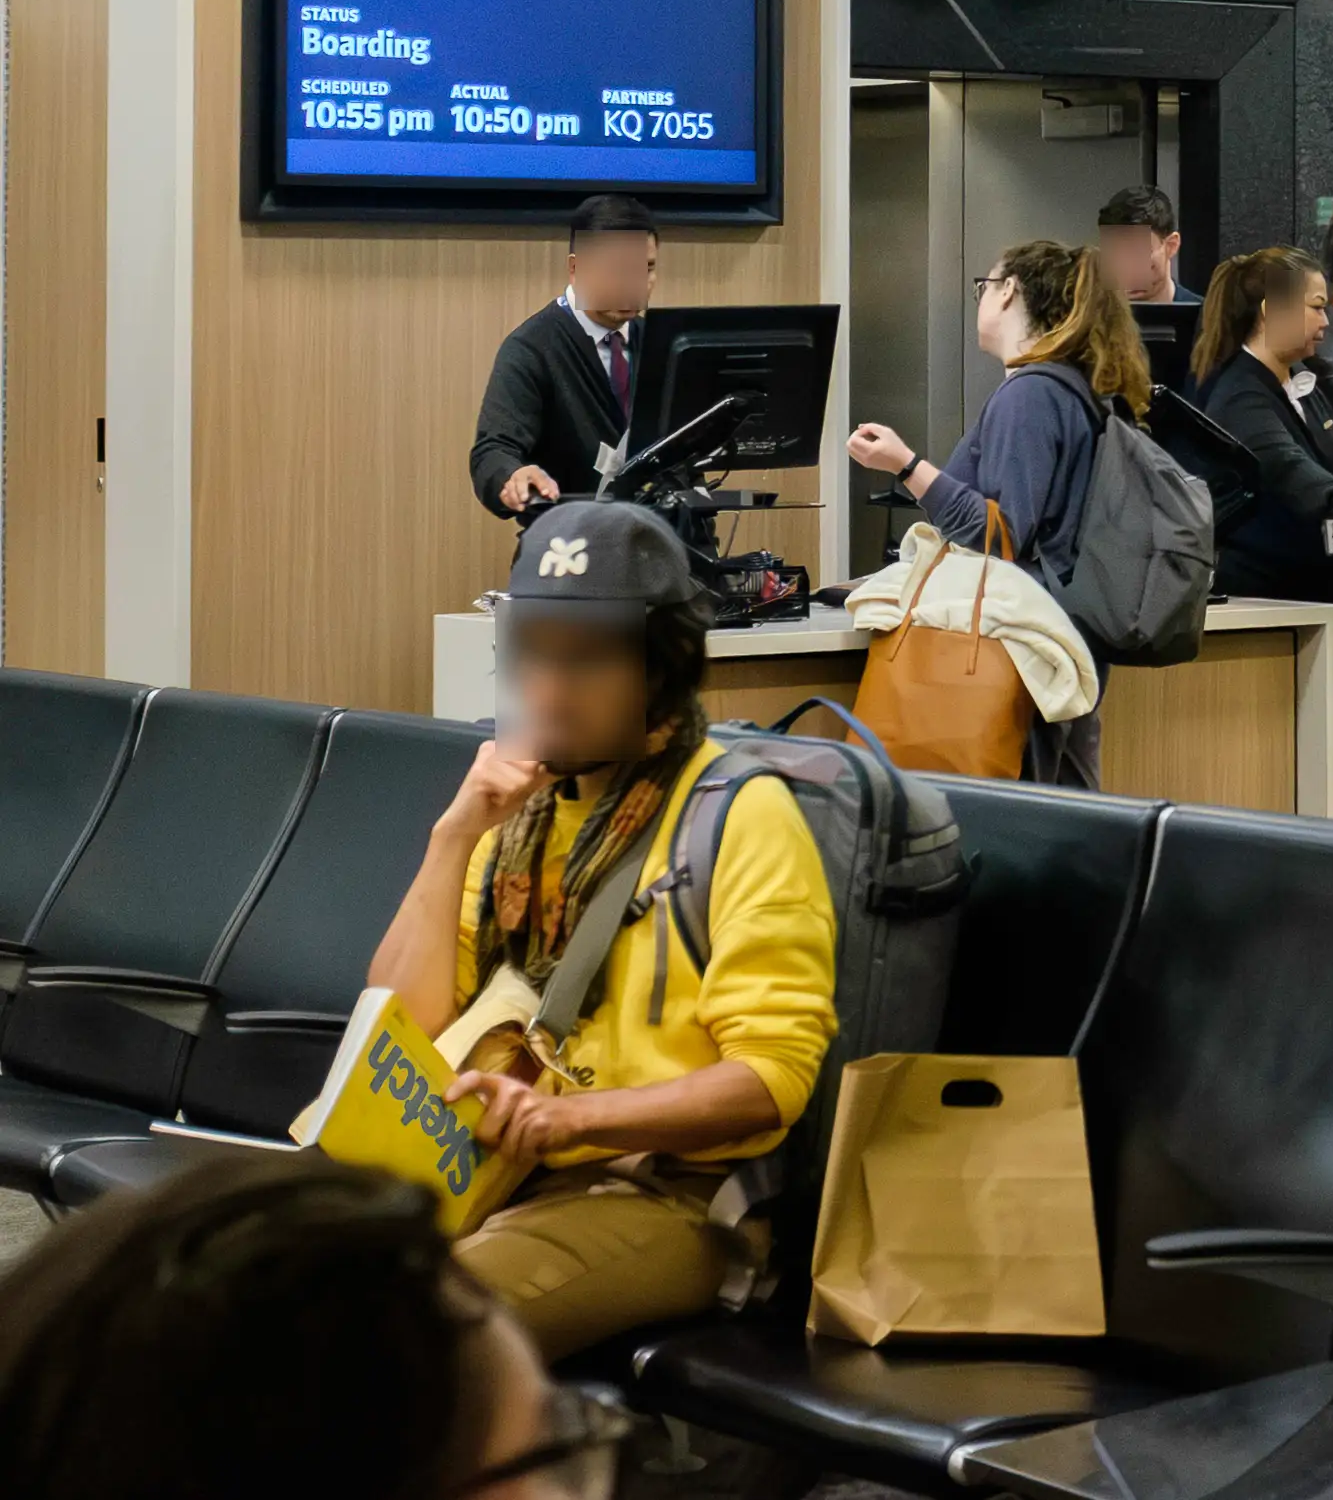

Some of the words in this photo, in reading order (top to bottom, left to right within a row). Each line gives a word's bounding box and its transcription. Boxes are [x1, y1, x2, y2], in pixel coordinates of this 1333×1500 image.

[301, 6, 359, 24] STATUS
[301, 28, 432, 66] Boarding
[301, 79, 391, 97] SCHEDULED
[451, 84, 509, 101] ACTUAL
[602, 90, 674, 107] PARTNERS
[301, 100, 384, 131] 10:55
[388, 109, 434, 137] pm
[449, 104, 532, 135] 10:50
[536, 113, 580, 141] pm
[603, 110, 642, 142] KQ
[650, 112, 714, 140] 7055
[367, 1030, 477, 1197] Sketch
